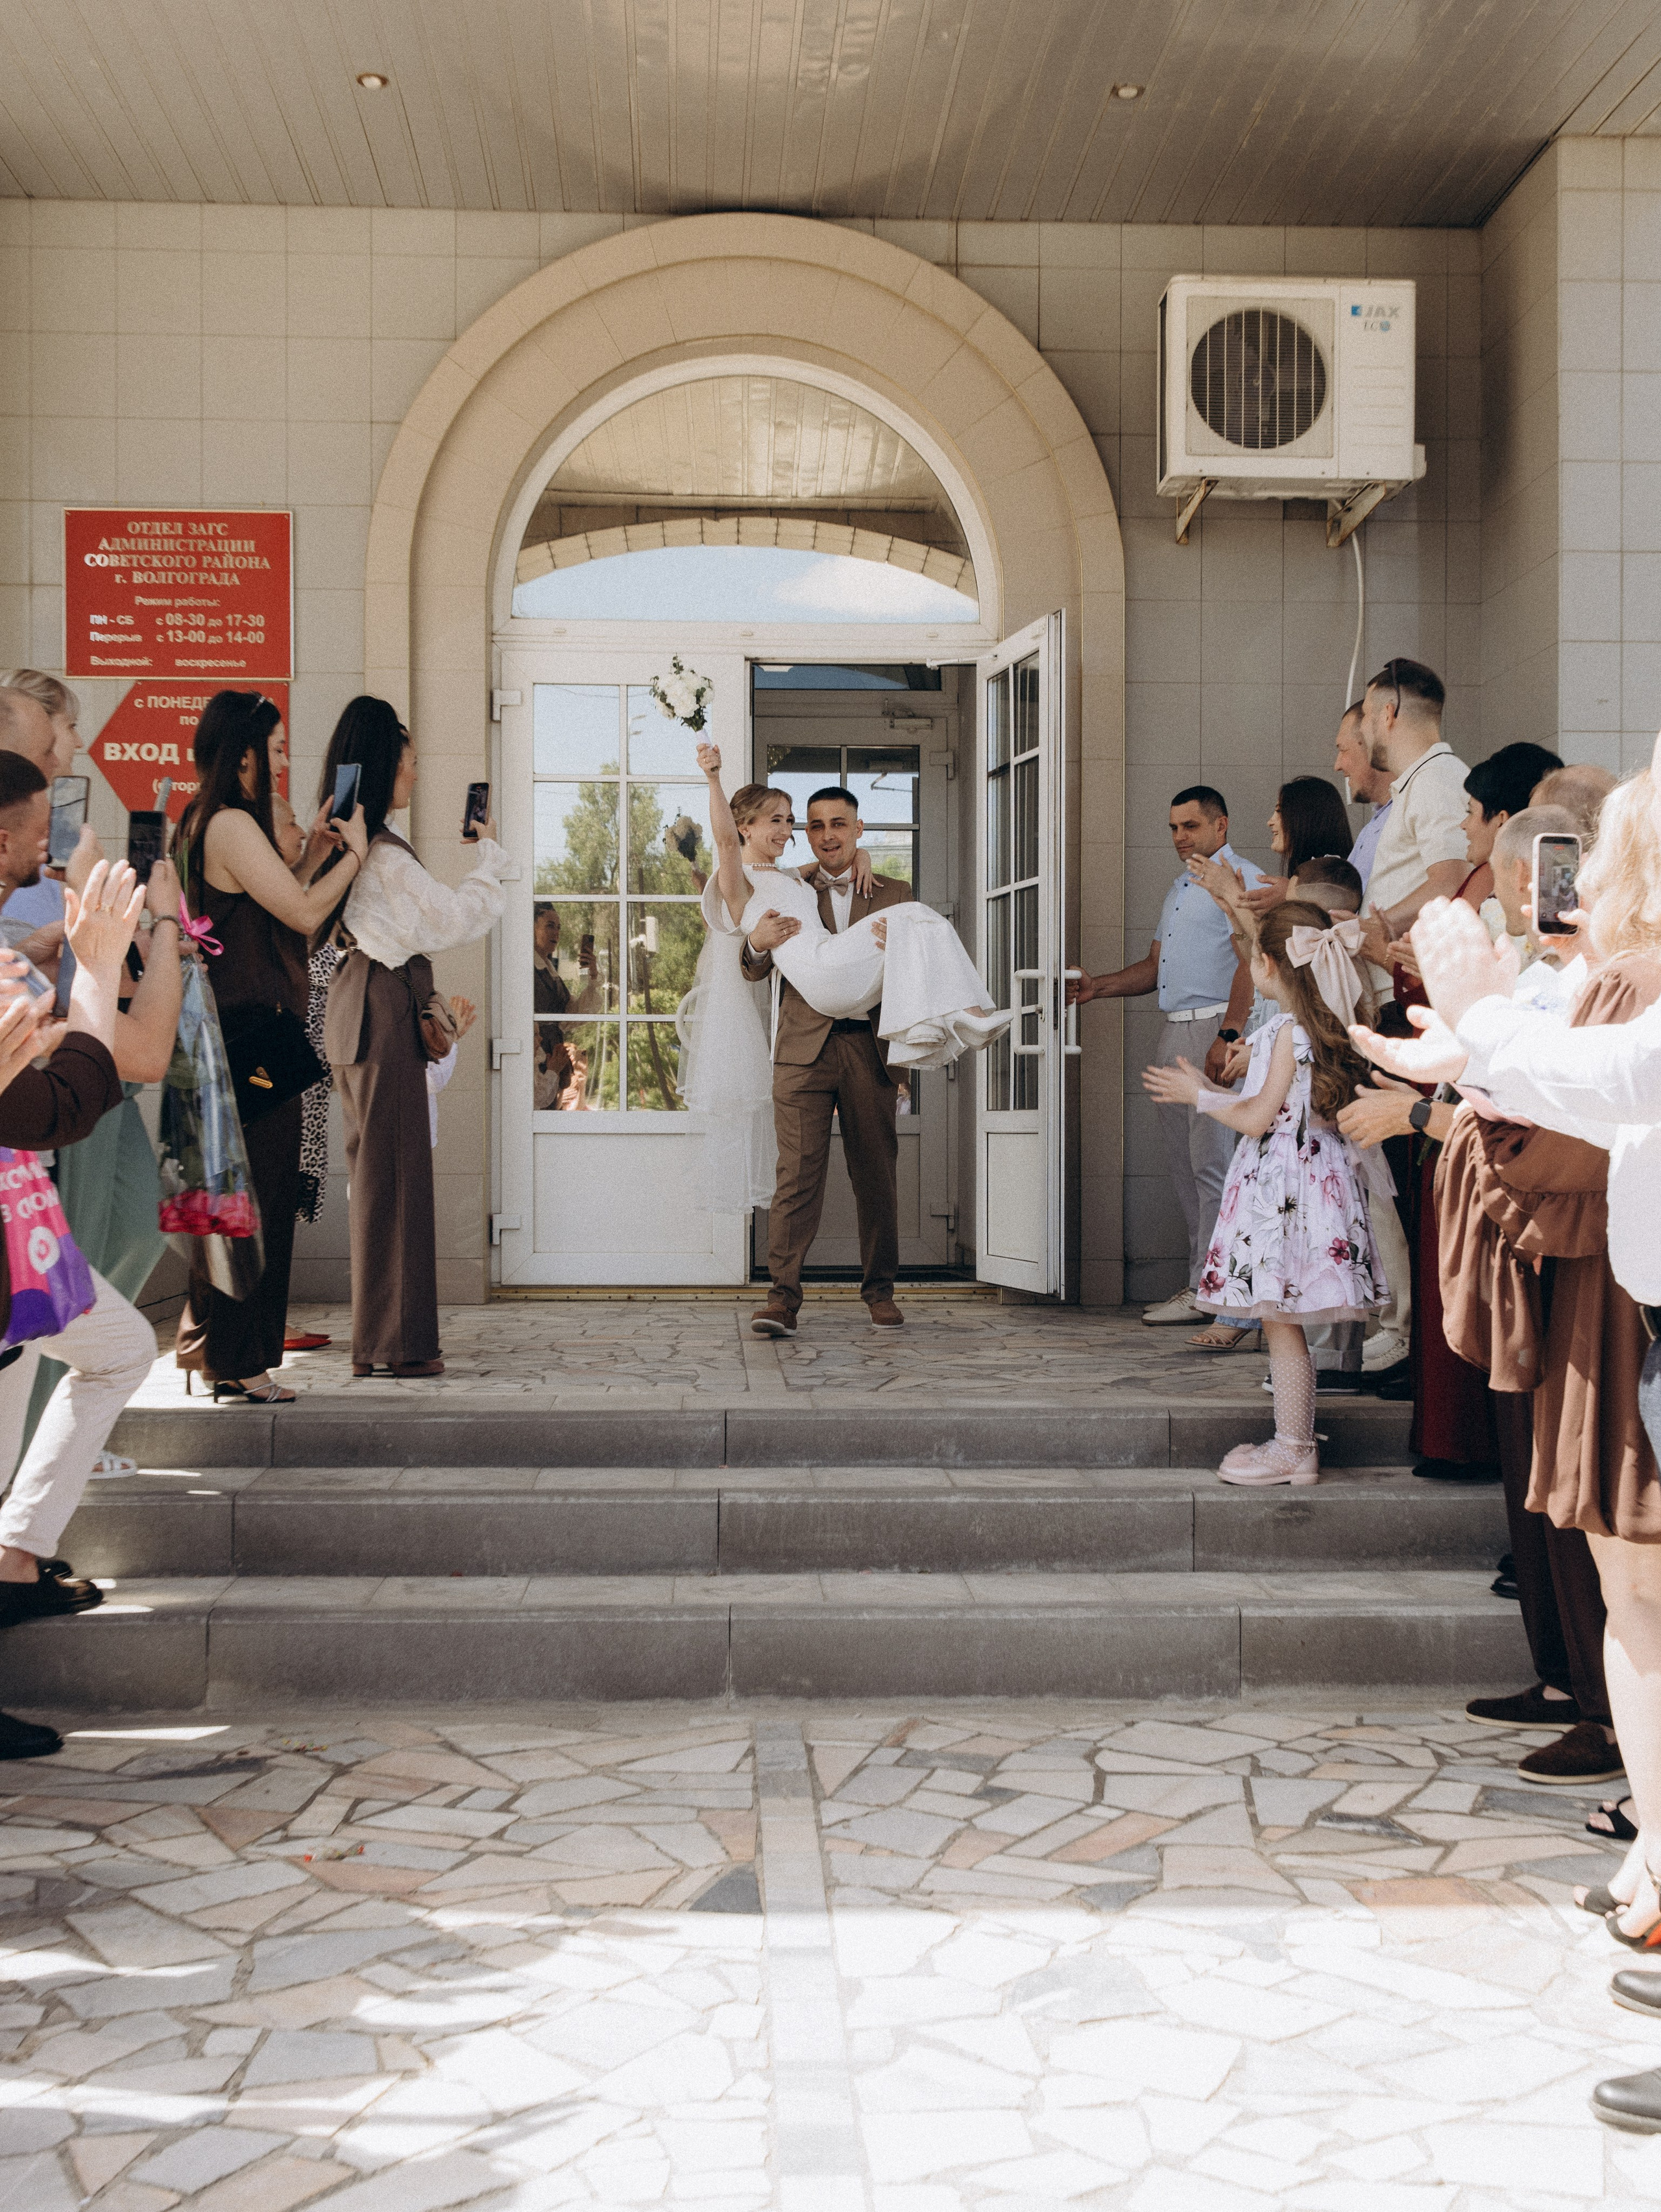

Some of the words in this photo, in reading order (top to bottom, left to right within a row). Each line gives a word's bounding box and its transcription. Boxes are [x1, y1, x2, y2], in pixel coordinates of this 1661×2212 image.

[1365, 306, 1400, 318] JAX
[127, 522, 183, 535] ОТДЕЛ
[188, 522, 228, 536] ЗАГС
[99, 538, 255, 553] АДМИНИСТРАЦИИ
[84, 553, 197, 568] СОВЕТСКОГО
[202, 551, 271, 569] РАЙОНА
[115, 573, 127, 584] г.
[132, 571, 241, 586] ВОЛГОГРАДА
[134, 595, 173, 607] Режим
[174, 596, 221, 608] работы:
[90, 614, 108, 625] ПН
[117, 615, 135, 625] СБ
[156, 617, 164, 625] с
[165, 613, 206, 627] 08-30
[208, 618, 223, 627] до
[226, 614, 265, 627] 17-30
[90, 631, 143, 644] Перерыв
[156, 633, 164, 643] с
[166, 630, 206, 643] 13-00
[208, 635, 223, 645] до
[226, 631, 265, 644] 14-00
[90, 655, 153, 667] Выходной:
[175, 658, 247, 669] воскресенье
[133, 698, 145, 708] с
[147, 695, 213, 711] ПОНЕДЕ
[104, 743, 180, 765] ВХОД
